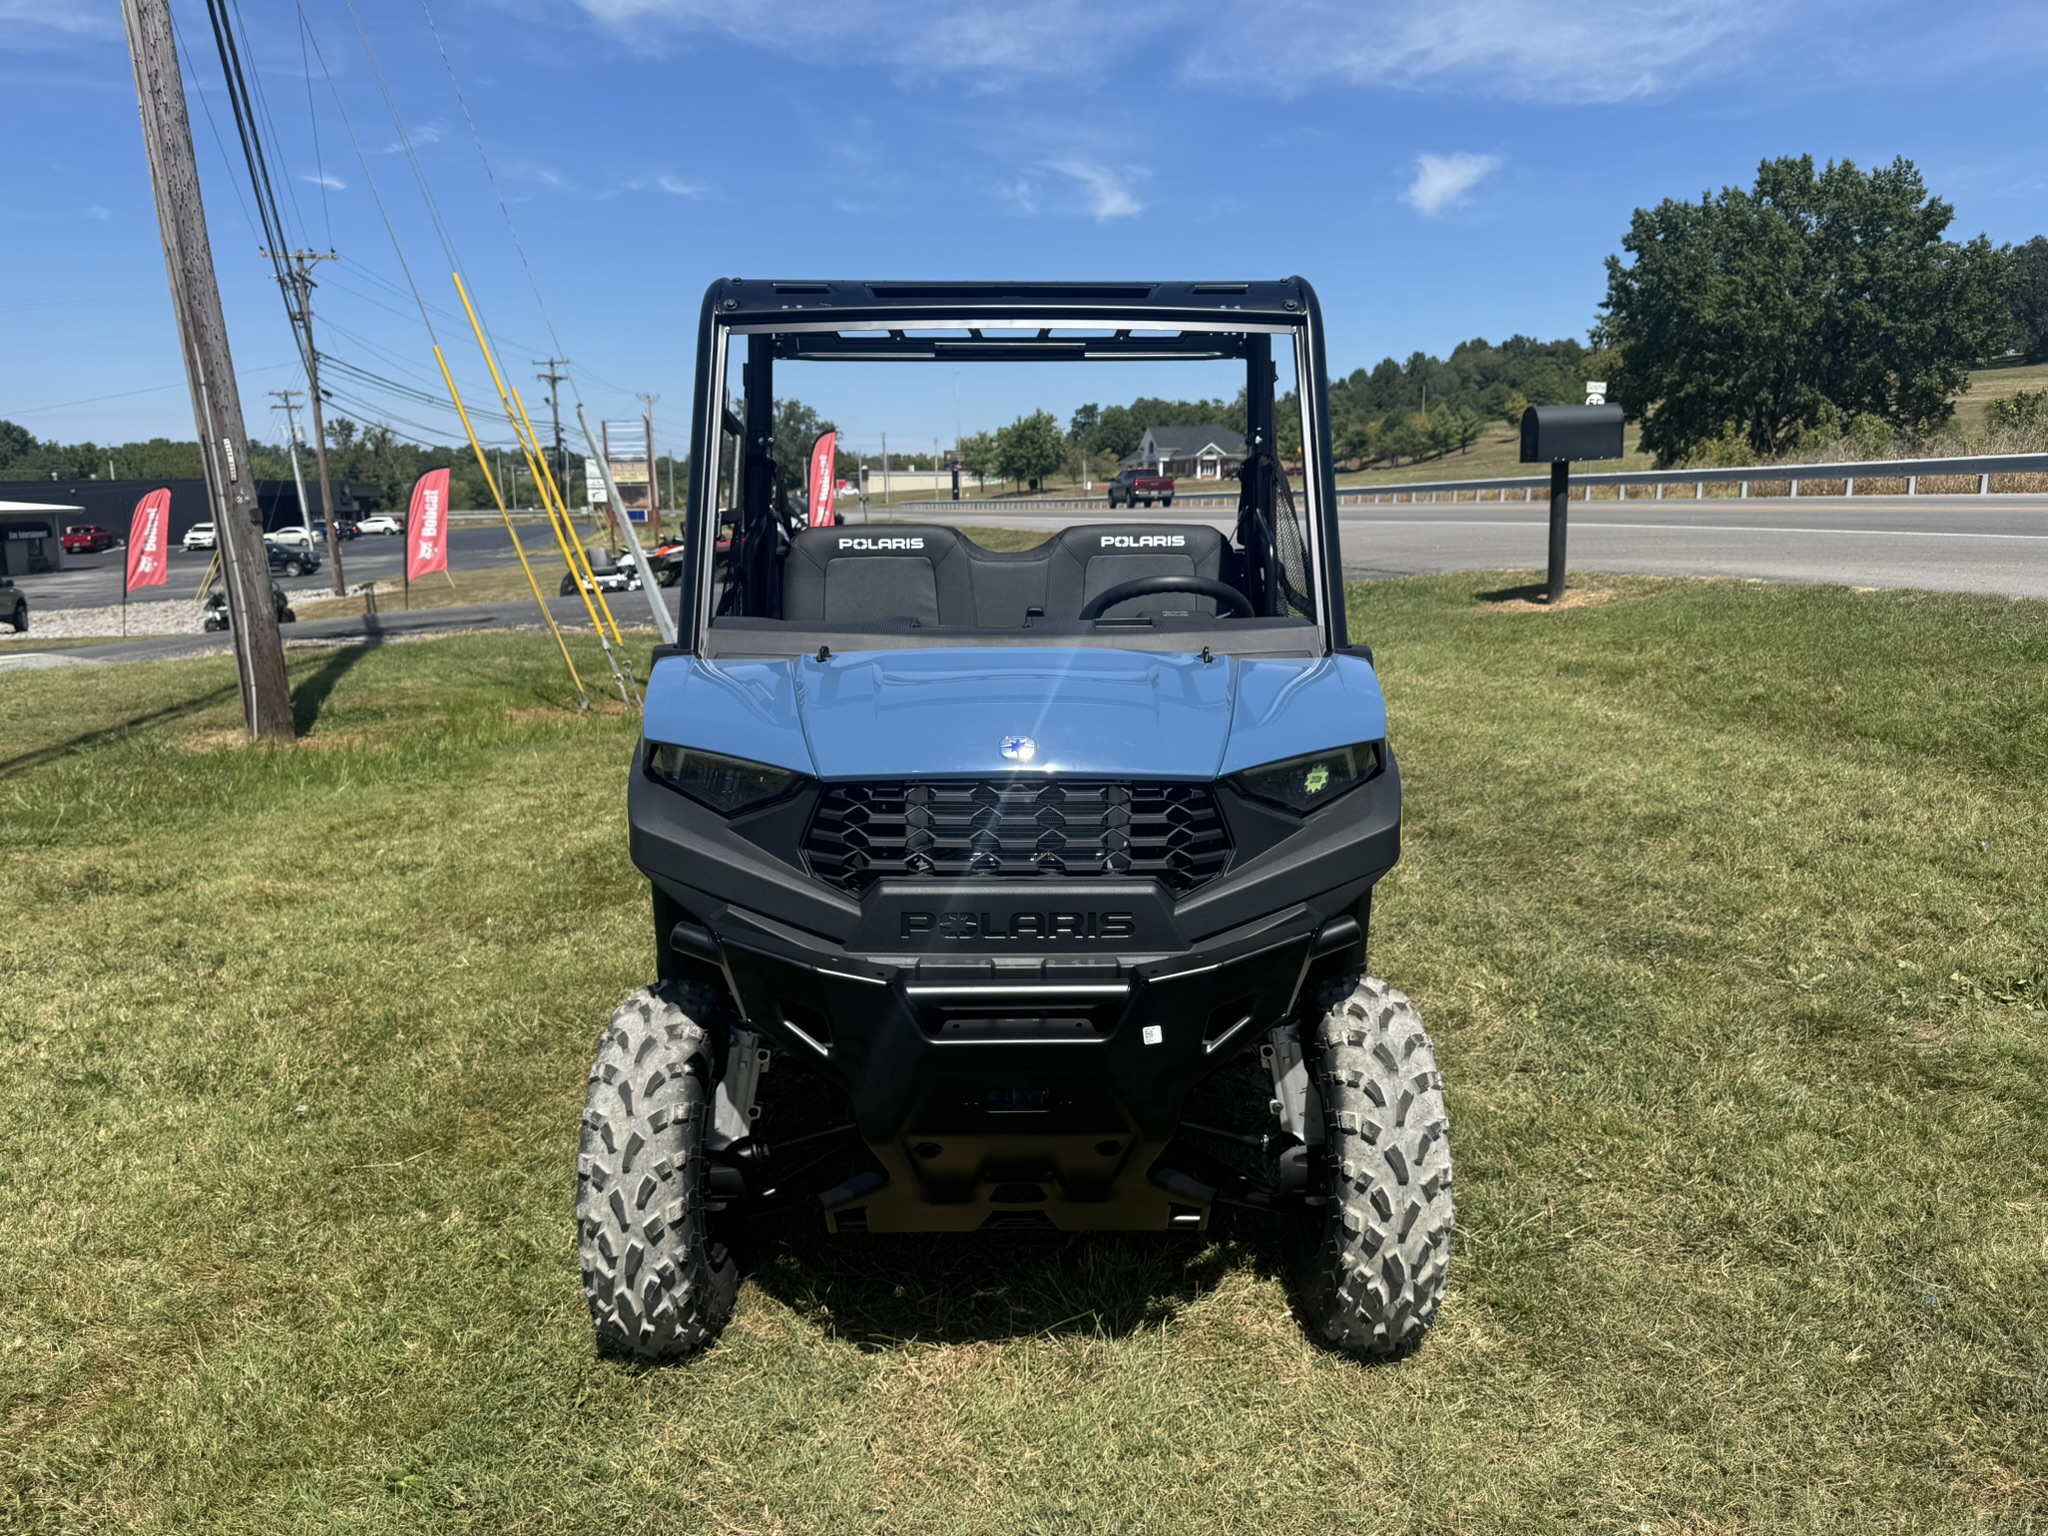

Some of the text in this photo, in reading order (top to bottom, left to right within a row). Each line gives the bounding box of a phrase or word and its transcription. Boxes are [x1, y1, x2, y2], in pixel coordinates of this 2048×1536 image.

[421, 490, 439, 537] Bobcat
[838, 538, 924, 550] POLARIS
[1101, 535, 1186, 548] POLARIS
[900, 912, 1136, 939] POLARIS
